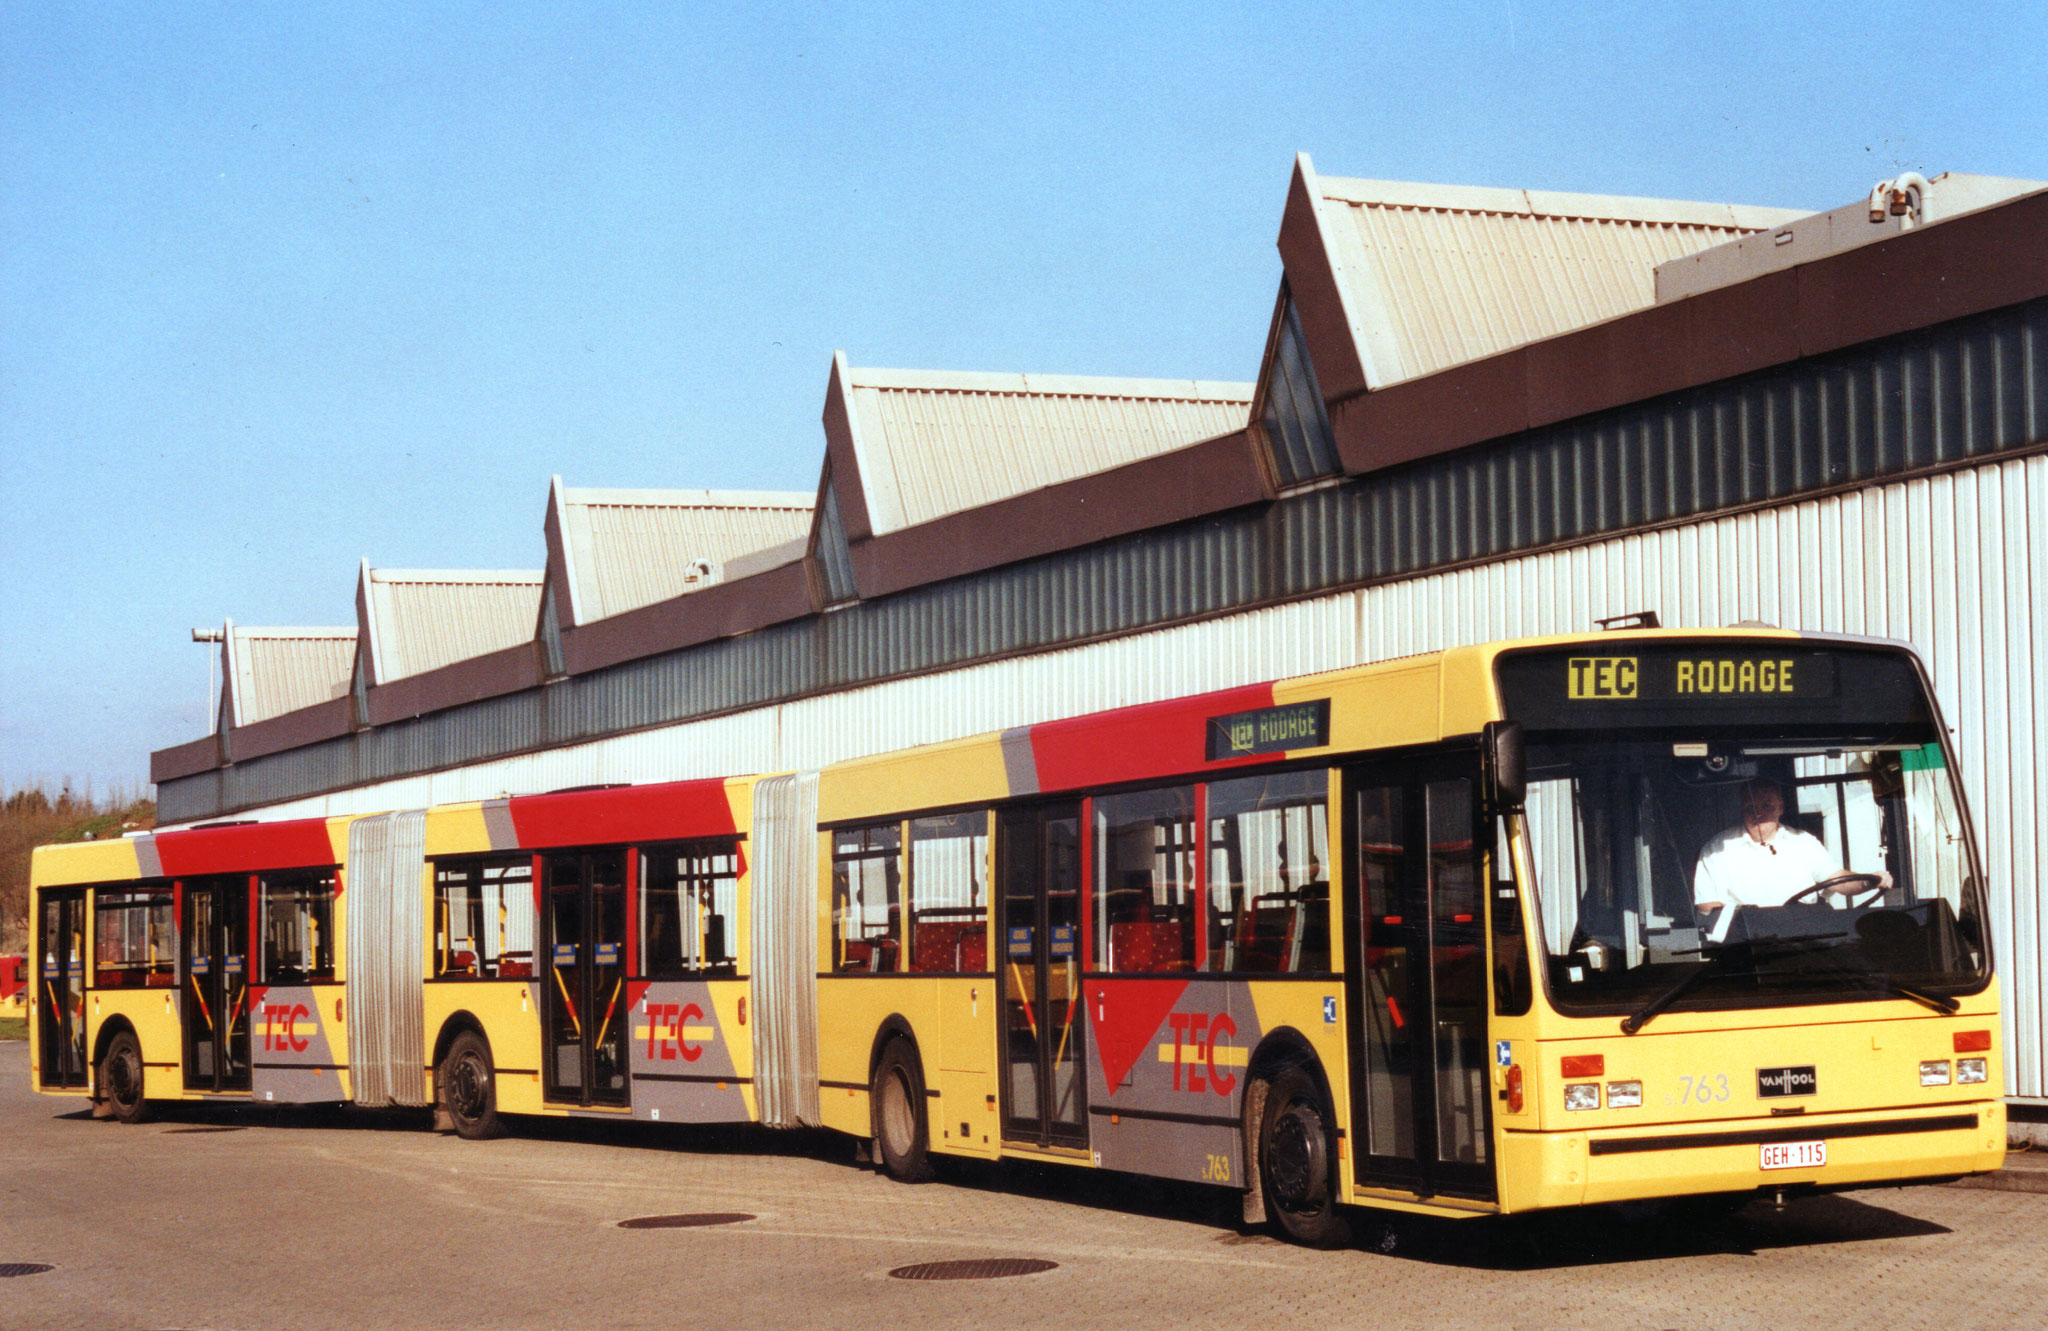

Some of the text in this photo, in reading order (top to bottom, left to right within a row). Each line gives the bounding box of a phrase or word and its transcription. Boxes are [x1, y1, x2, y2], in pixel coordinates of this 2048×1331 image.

[1570, 658, 1794, 698] TEC RODAGE
[1261, 707, 1316, 742] RODAGE
[263, 1003, 310, 1053] TEC
[644, 1003, 704, 1062] TEC
[1169, 1012, 1237, 1096] TEC
